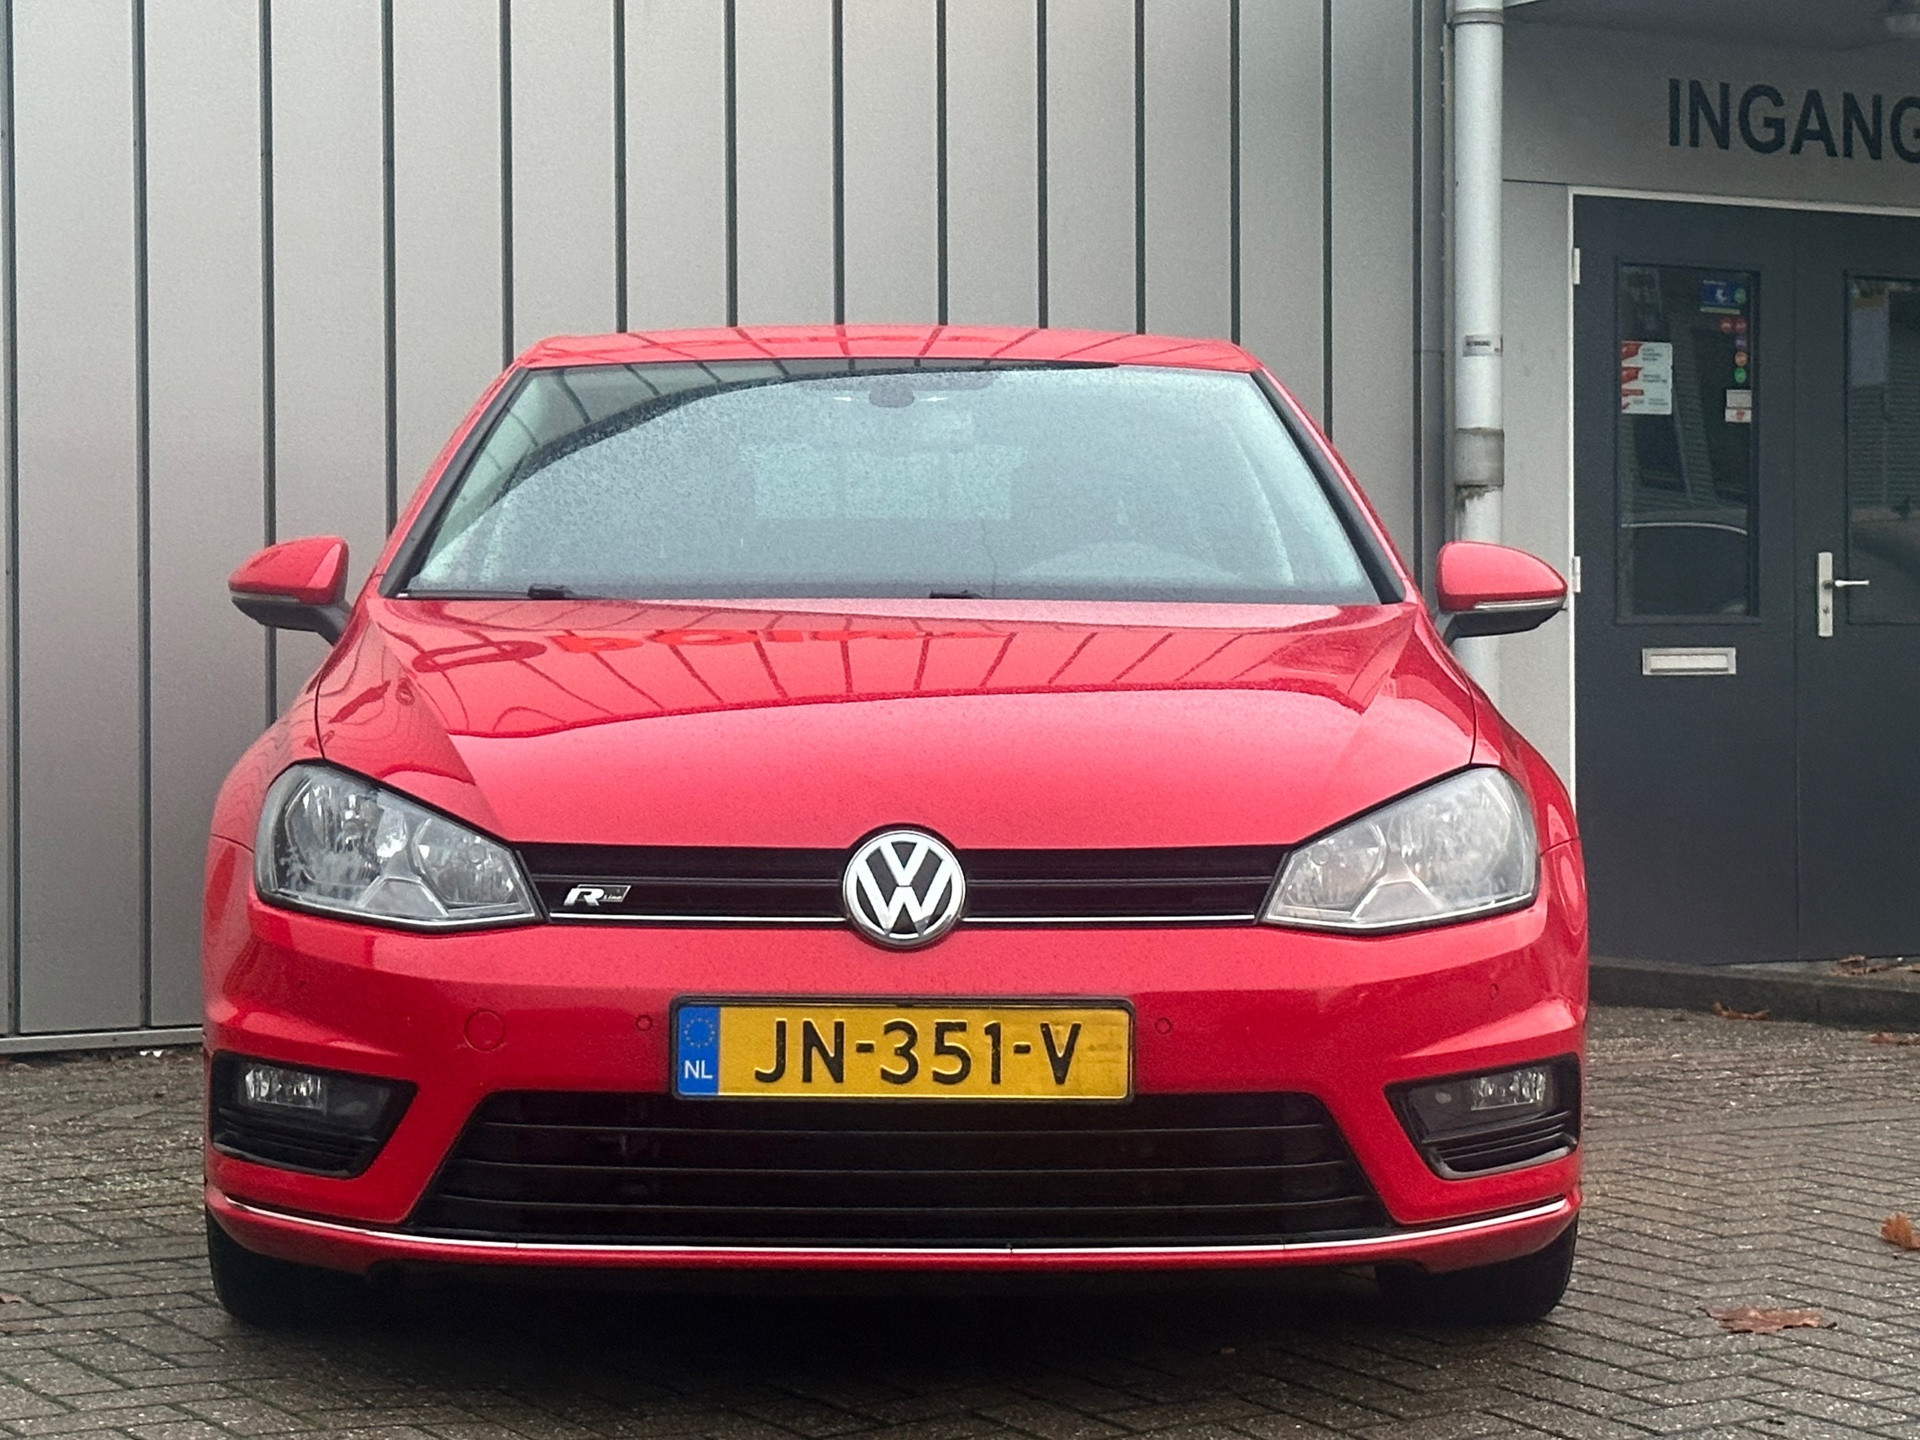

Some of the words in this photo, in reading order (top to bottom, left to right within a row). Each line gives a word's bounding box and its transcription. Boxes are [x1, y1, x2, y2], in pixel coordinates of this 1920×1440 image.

[1669, 78, 1920, 163] INGANG
[847, 832, 963, 940] VW
[684, 1060, 713, 1079] NL
[754, 1018, 1082, 1085] JN-351-V
